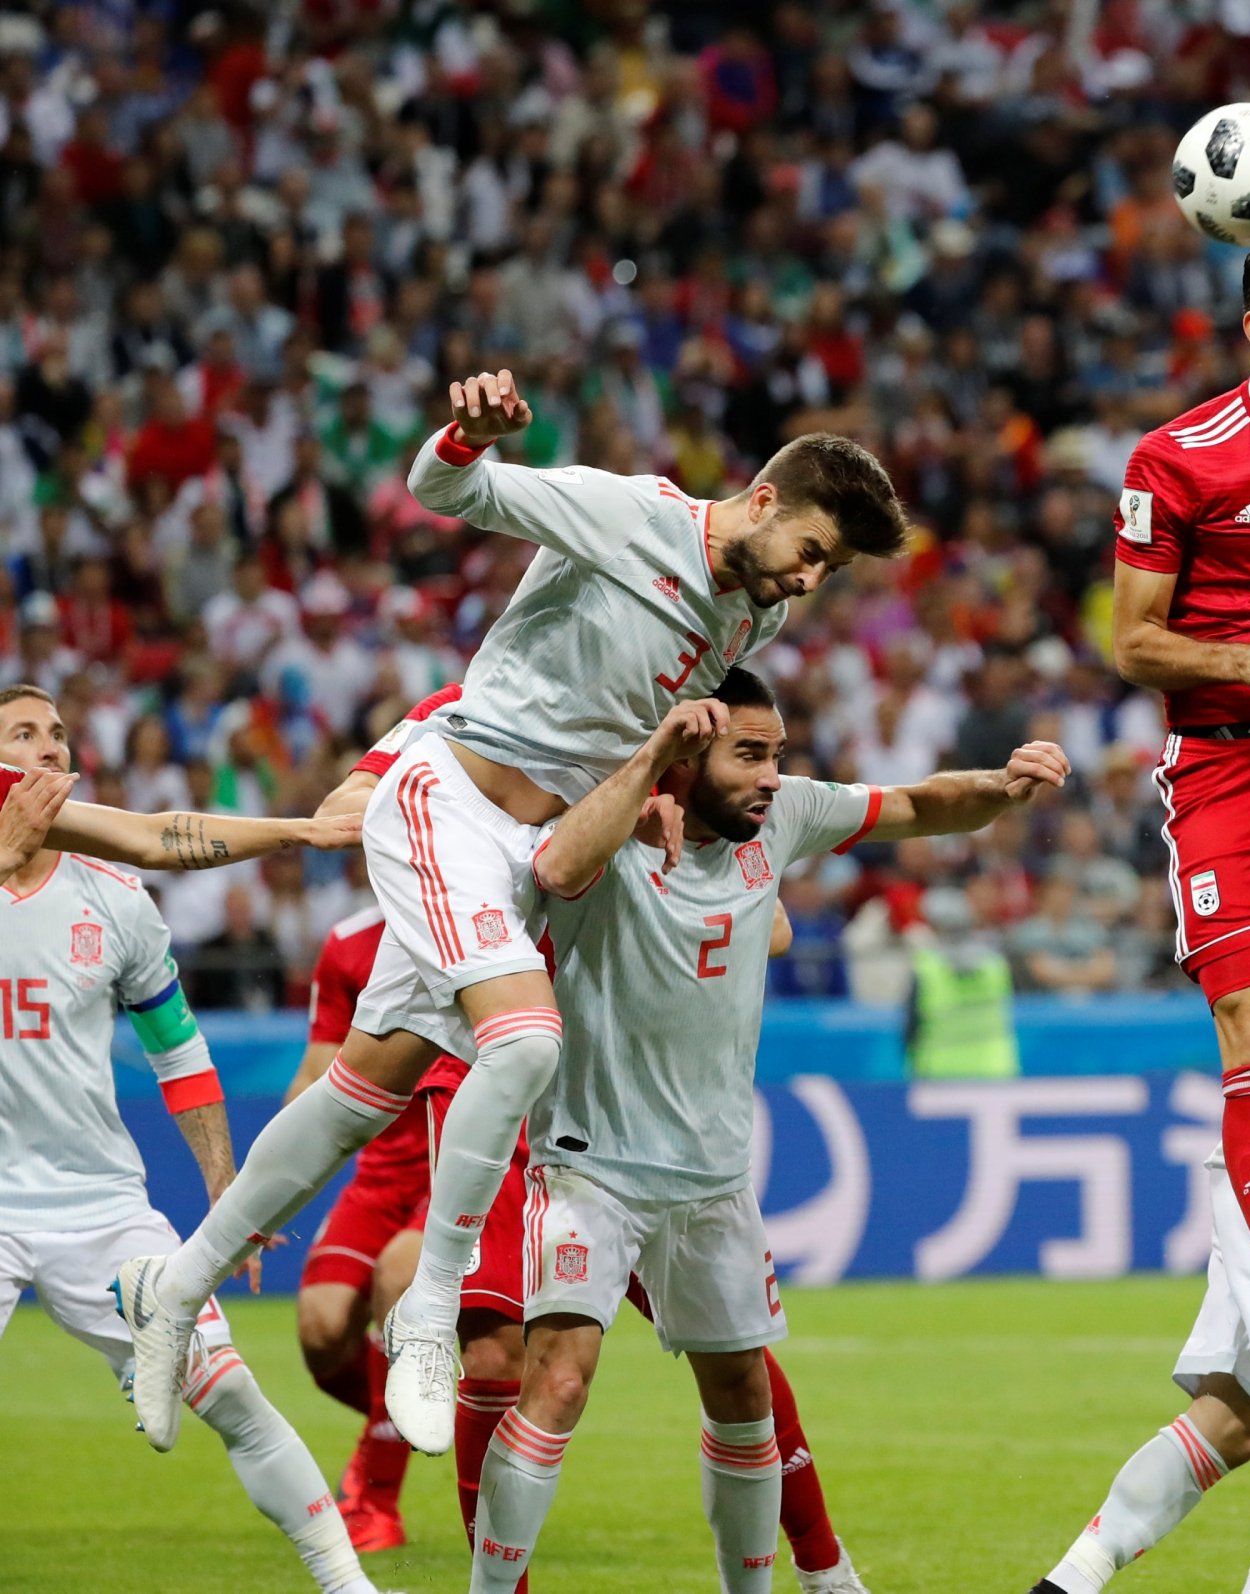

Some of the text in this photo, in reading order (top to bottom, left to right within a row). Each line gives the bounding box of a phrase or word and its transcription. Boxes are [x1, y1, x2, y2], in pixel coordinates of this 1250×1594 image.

[652, 577, 681, 603] adidas
[655, 631, 711, 694] 3
[697, 912, 733, 979] 2
[0, 978, 51, 1039] 15
